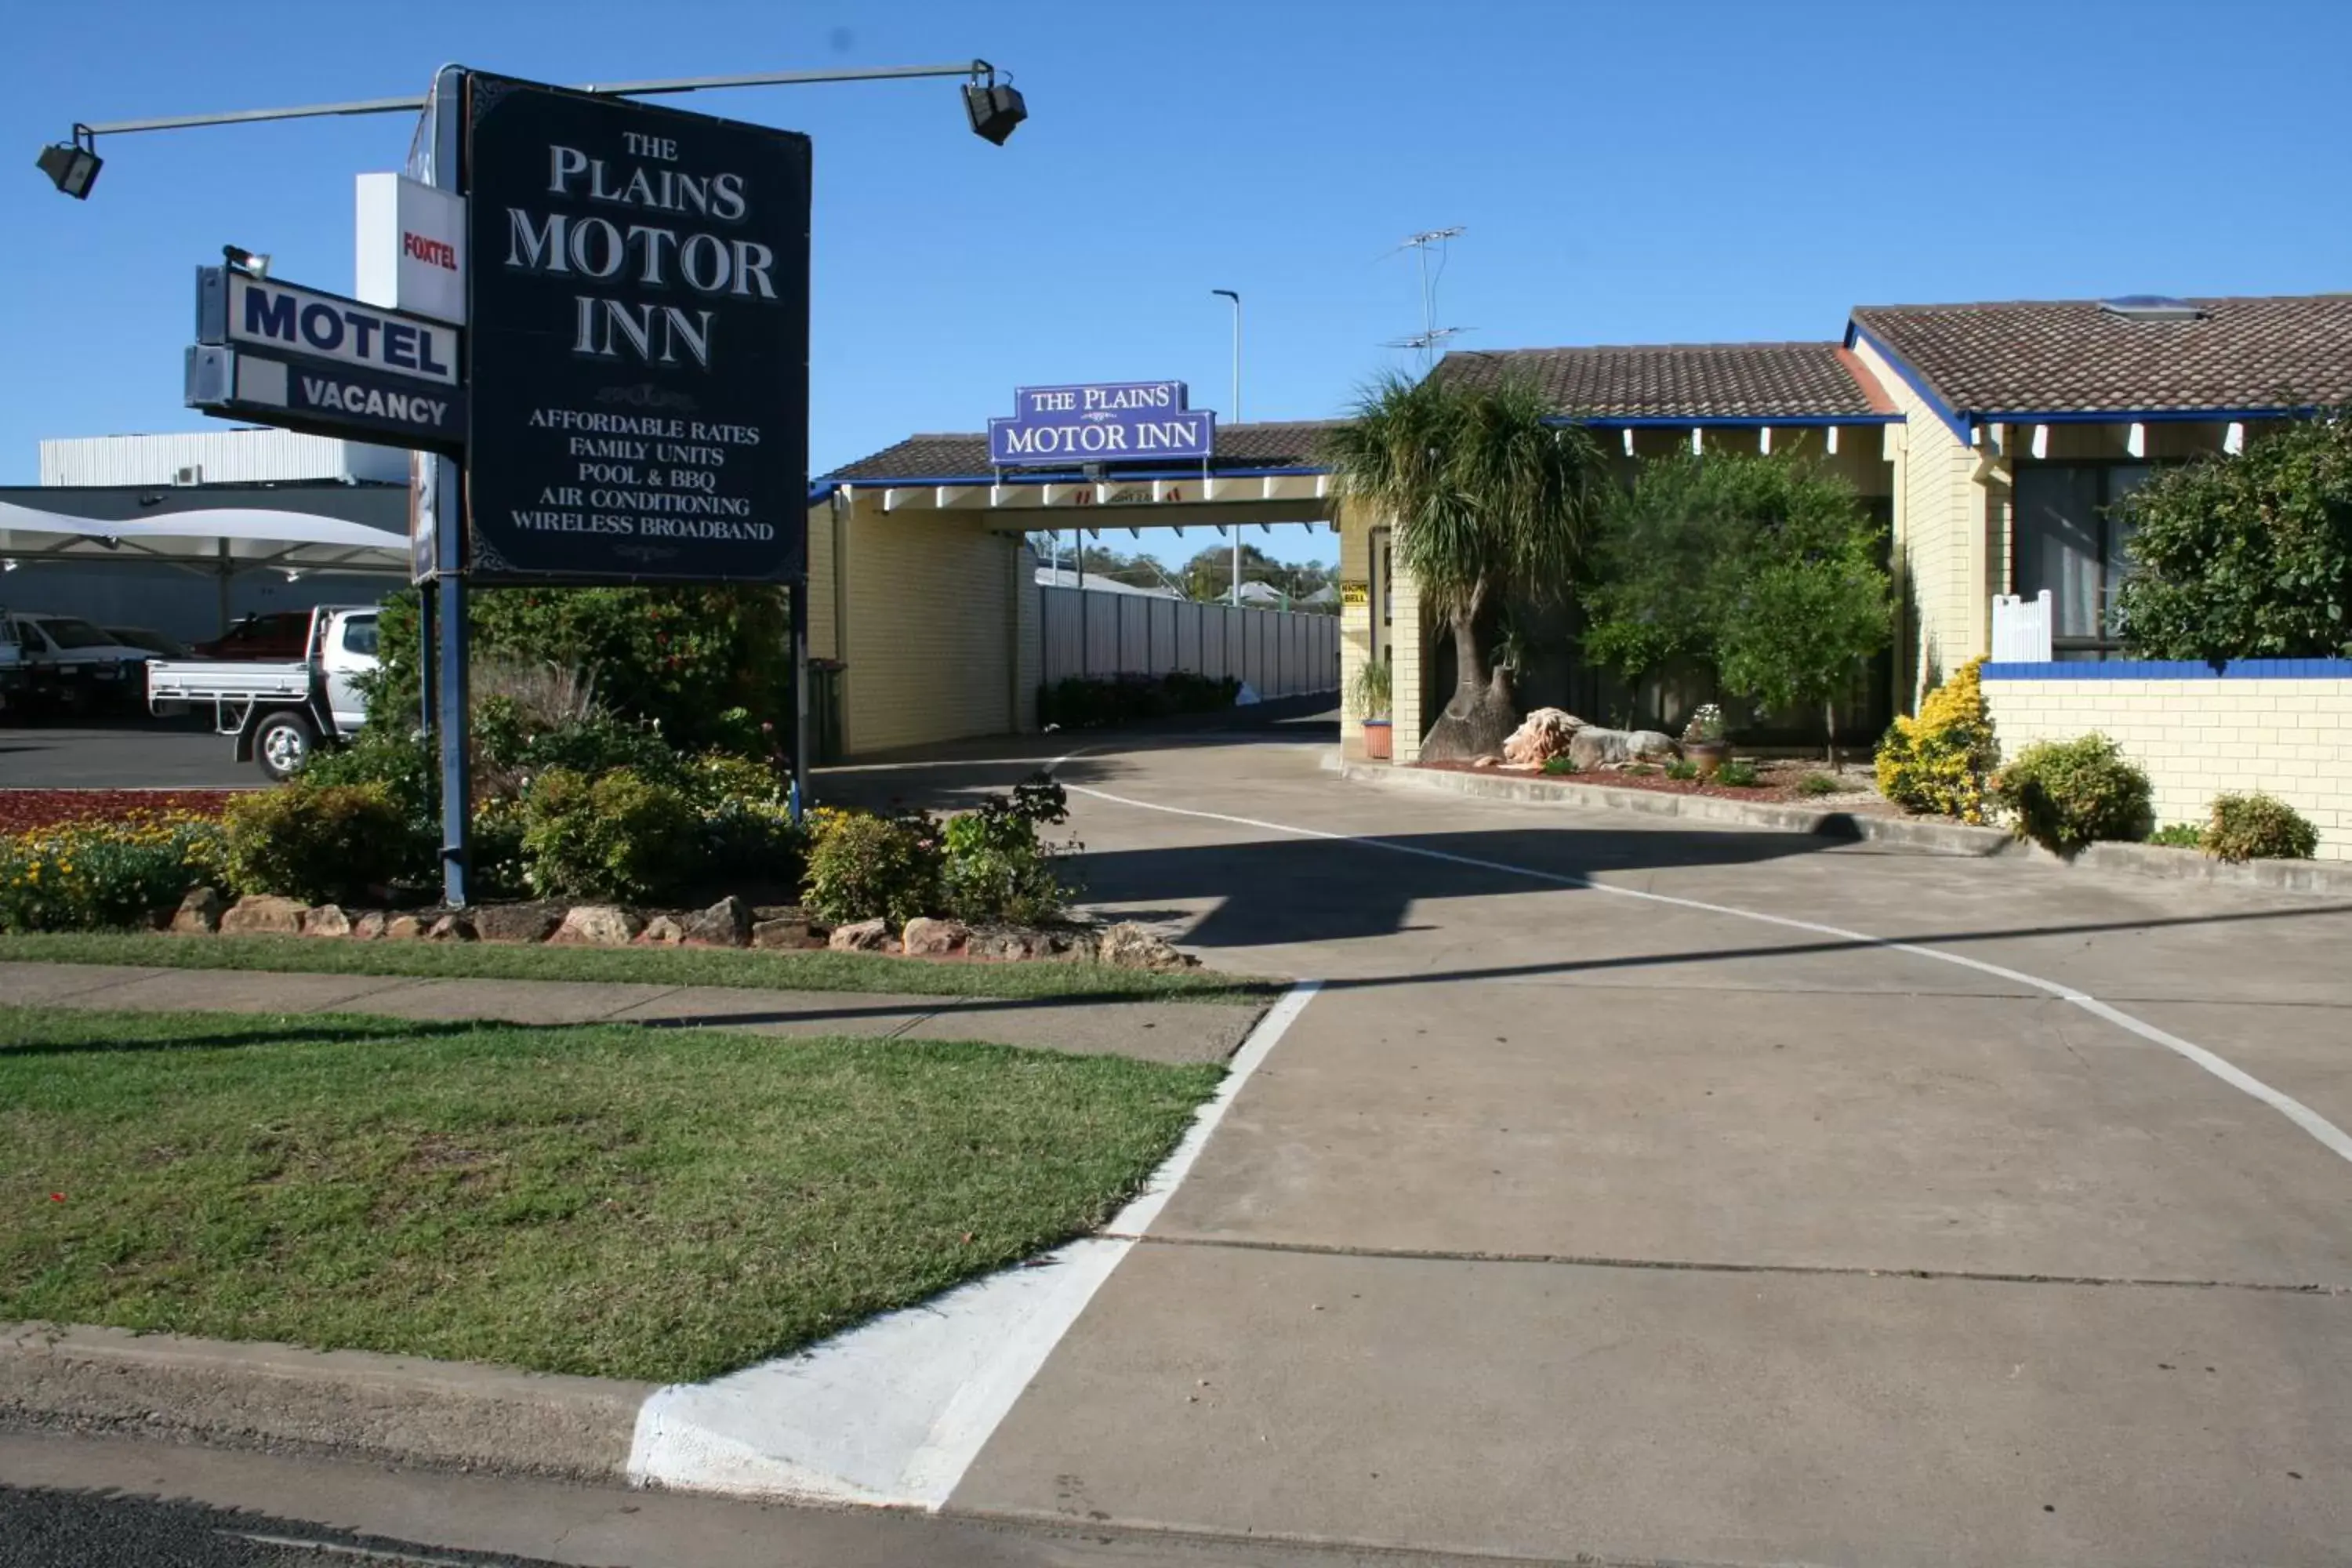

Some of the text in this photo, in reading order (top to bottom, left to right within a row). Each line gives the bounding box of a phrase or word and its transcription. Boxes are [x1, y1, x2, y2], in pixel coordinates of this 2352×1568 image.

[622, 132, 678, 162] THE
[548, 144, 746, 220] PLAINS
[404, 231, 457, 271] FOXTEL
[505, 207, 778, 299] MOTOR
[246, 286, 448, 376] MOTEL
[572, 296, 716, 367] INN
[302, 376, 449, 426] VACANCY
[1031, 385, 1170, 412] THE PLAINS
[528, 408, 760, 445] AFFORDABLE RATES
[1006, 422, 1198, 454] MOTOR INN
[569, 437, 724, 466] FAMILY UNITS
[579, 463, 716, 493] POOL & BBQ
[539, 487, 750, 516] AIR CONDITIONING
[510, 510, 775, 541] WIRELESS BROADBAND
